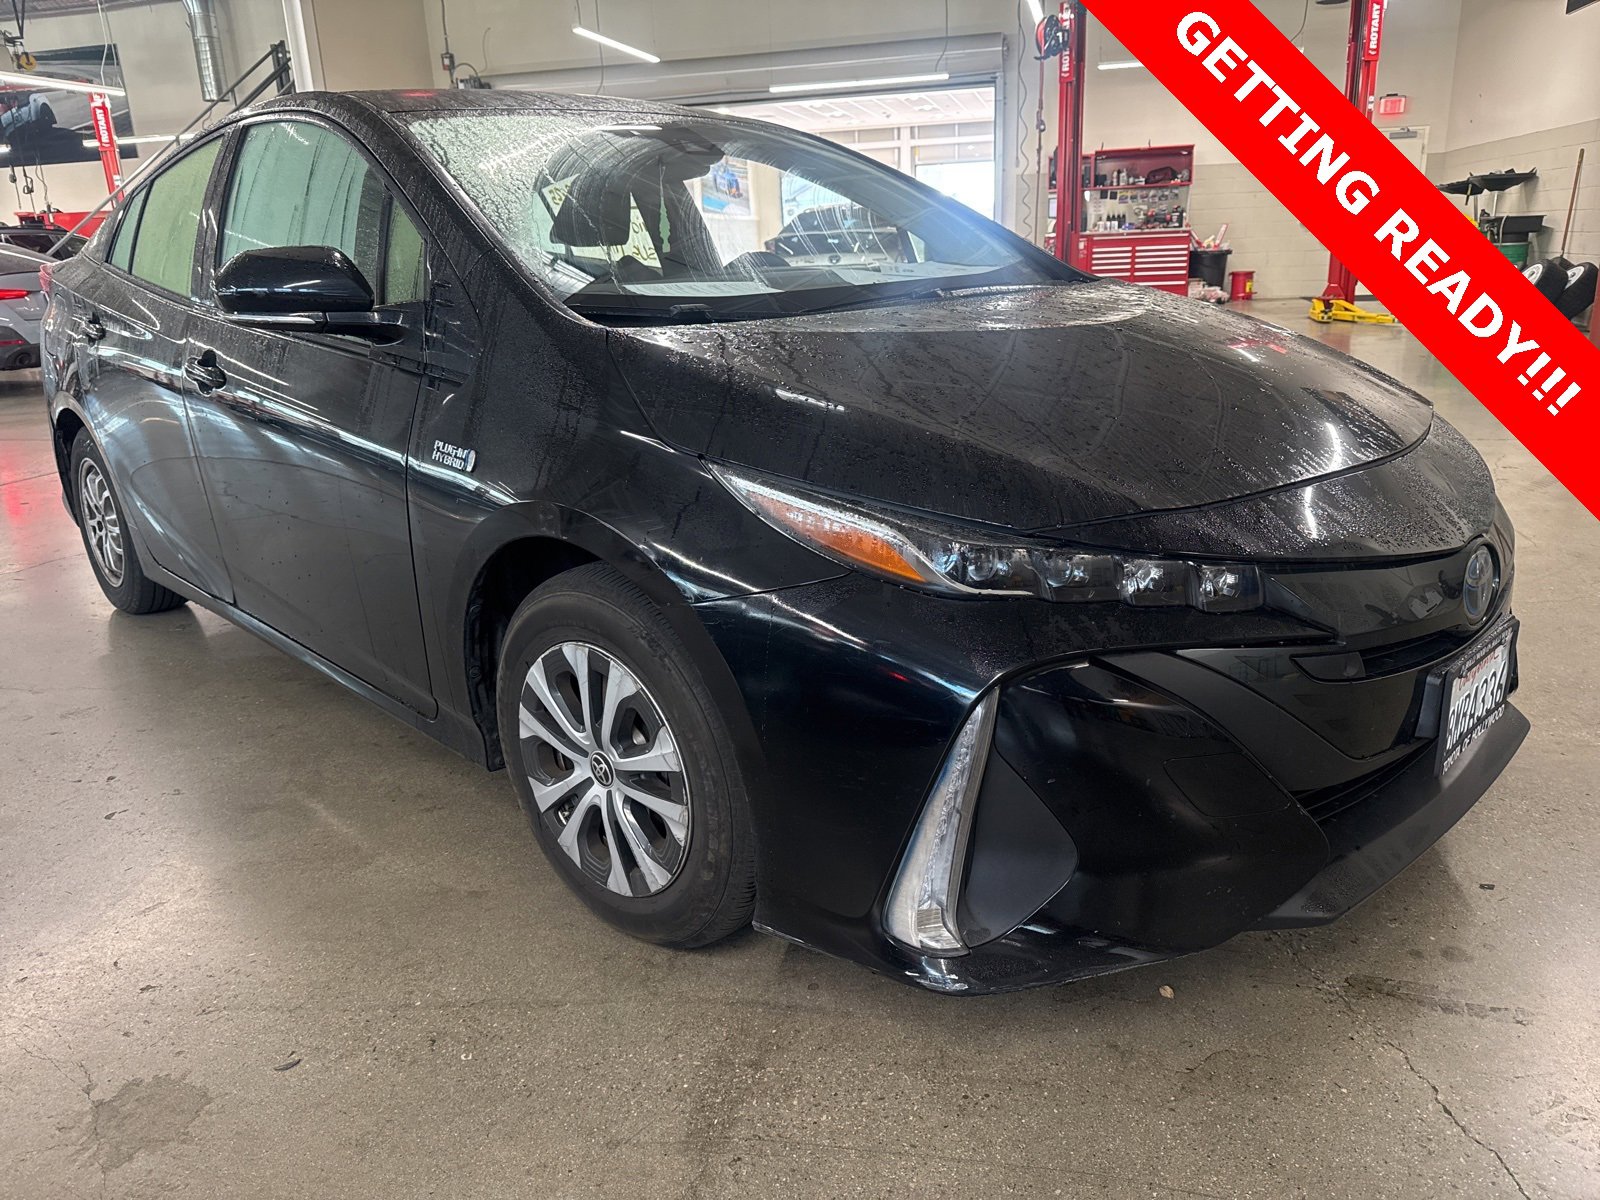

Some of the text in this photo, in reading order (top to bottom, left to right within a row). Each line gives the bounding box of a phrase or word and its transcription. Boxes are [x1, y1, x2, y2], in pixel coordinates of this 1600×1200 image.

[1369, 3, 1381, 49] ROTARY
[95, 108, 111, 143] ROTARY
[432, 450, 465, 470] HYBRID
[1462, 733, 1471, 752] OF
[1471, 703, 1505, 743] HOLLYWOOD
